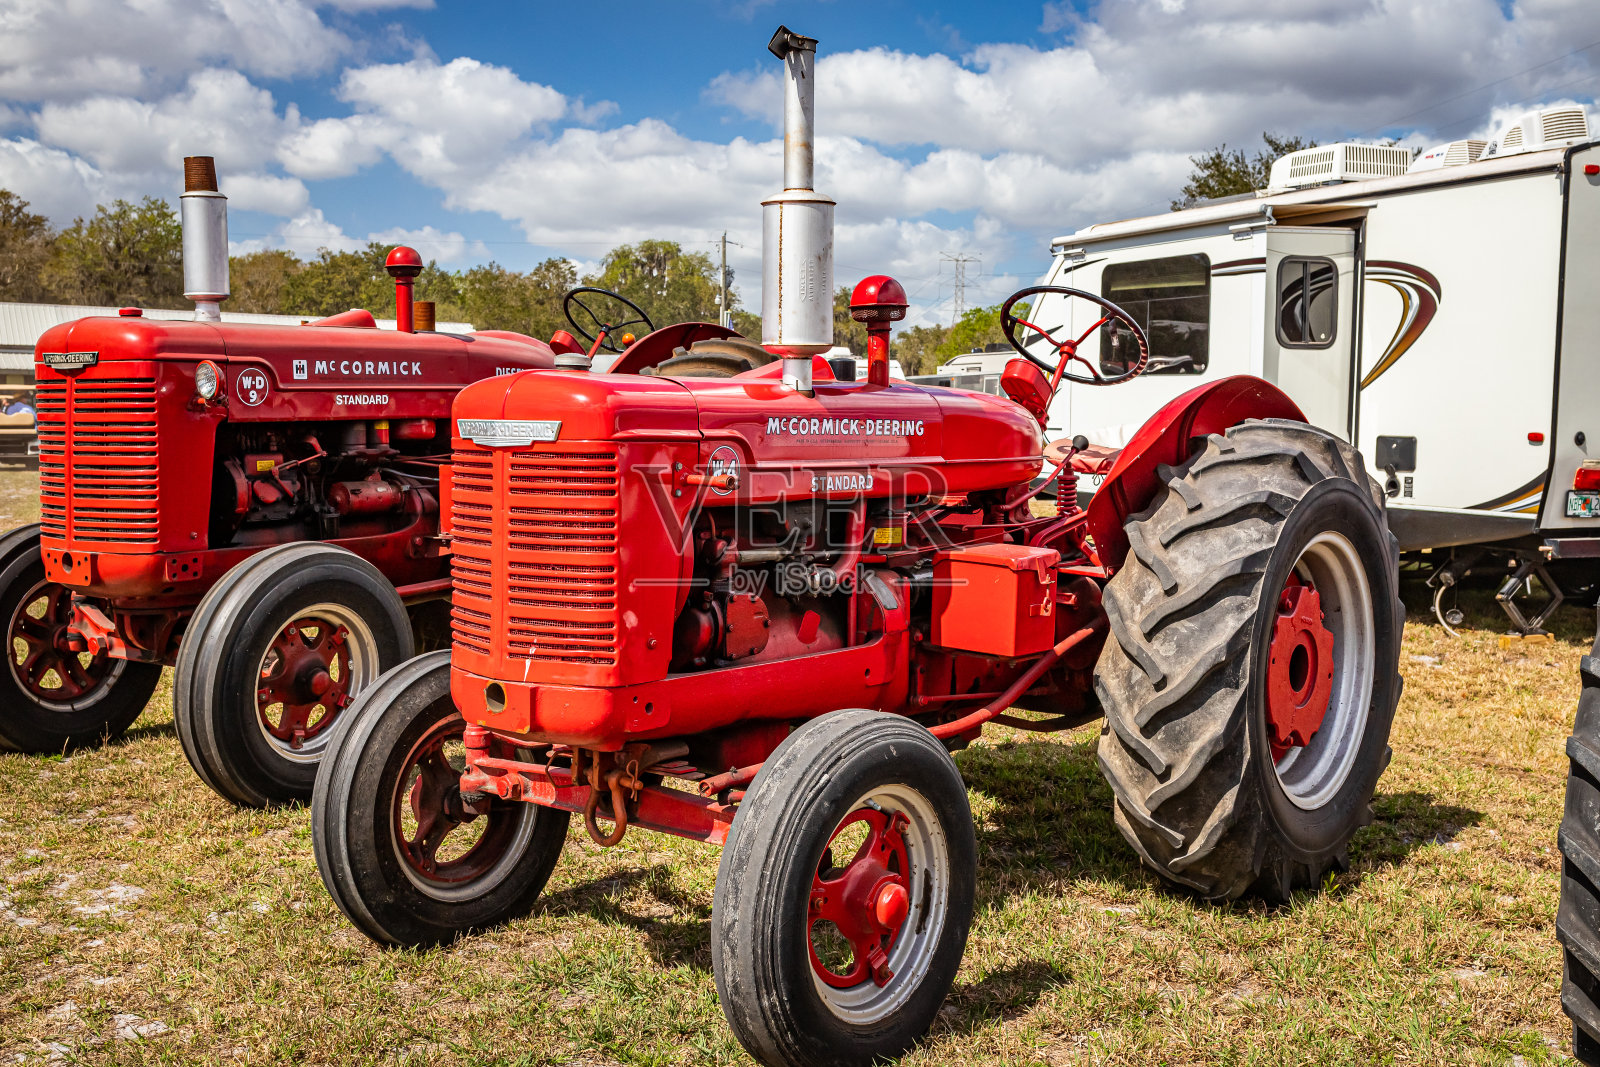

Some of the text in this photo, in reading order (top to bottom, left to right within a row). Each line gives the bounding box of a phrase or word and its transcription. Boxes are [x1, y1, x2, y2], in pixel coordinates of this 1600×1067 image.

[314, 360, 422, 376] McCORMICK
[249, 390, 258, 403] 9
[335, 394, 389, 405] STANDARD
[766, 416, 925, 437] McCORMICK-DEERING
[811, 474, 874, 493] STANDARD
